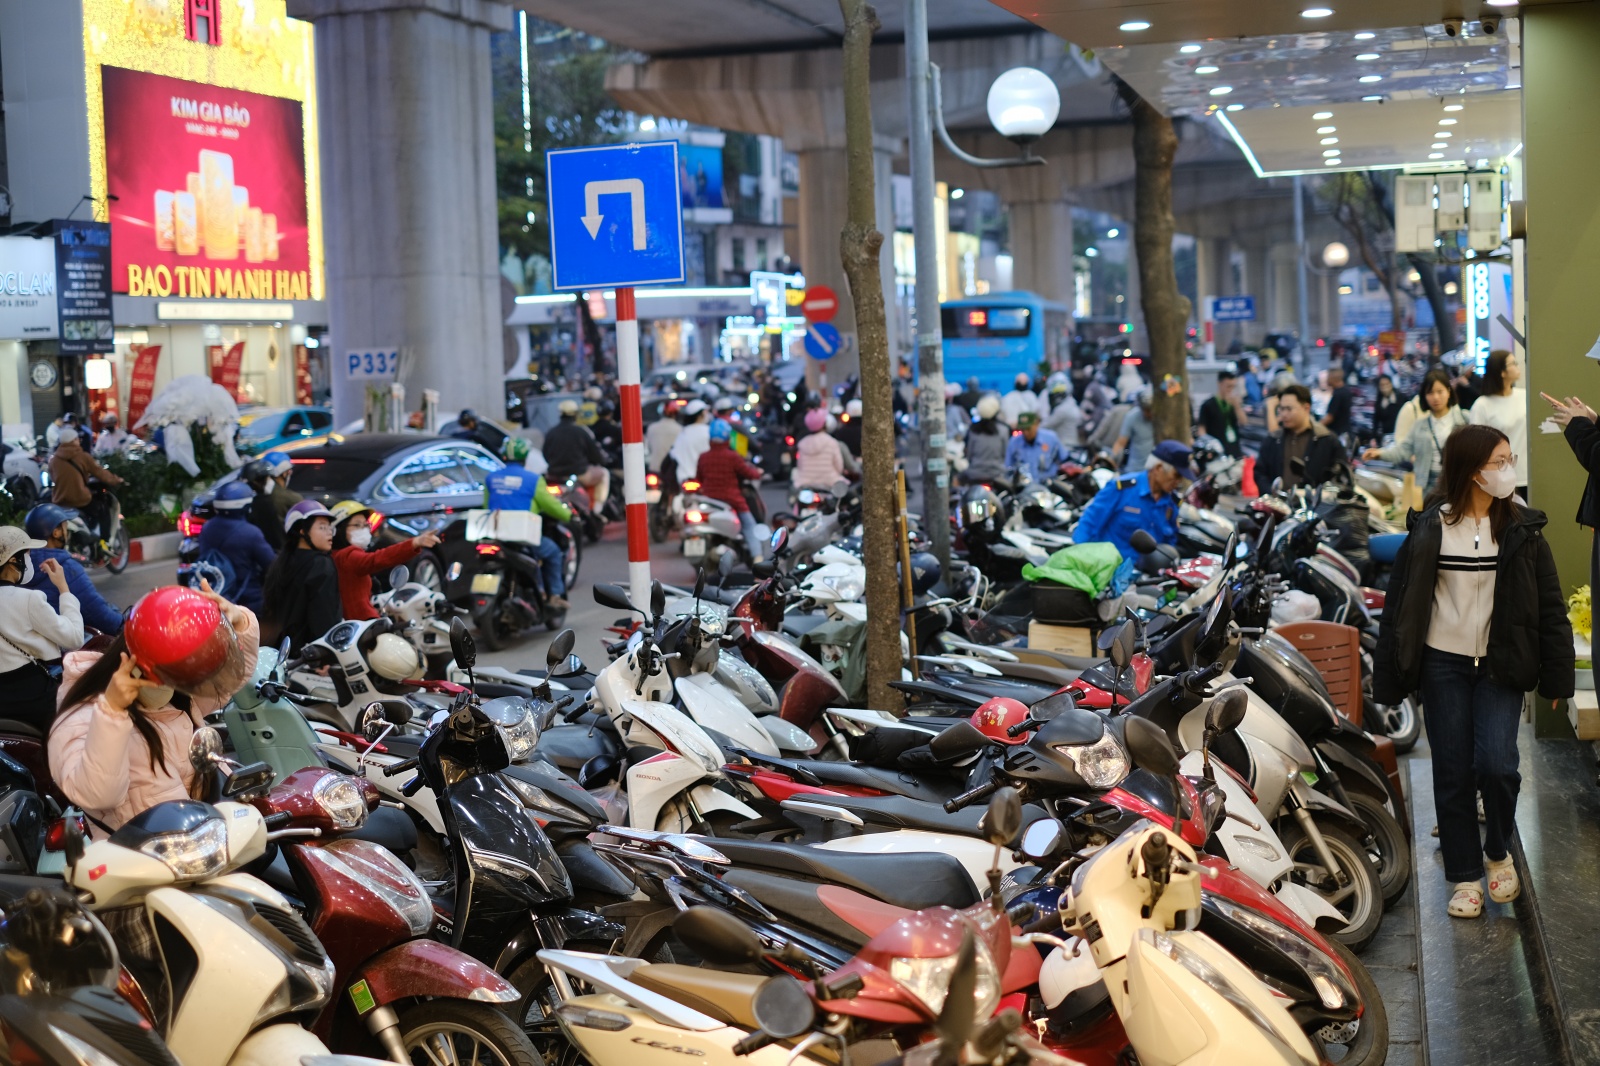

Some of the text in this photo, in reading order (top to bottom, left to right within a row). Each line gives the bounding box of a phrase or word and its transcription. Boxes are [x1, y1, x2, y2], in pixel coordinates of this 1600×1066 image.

[171, 96, 199, 120] KIM
[199, 101, 223, 124] GIA
[128, 264, 308, 300] BAO TIN MANH HAI
[636, 774, 662, 782] HONDA
[436, 922, 454, 935] HON
[630, 1037, 706, 1057] LEAD
